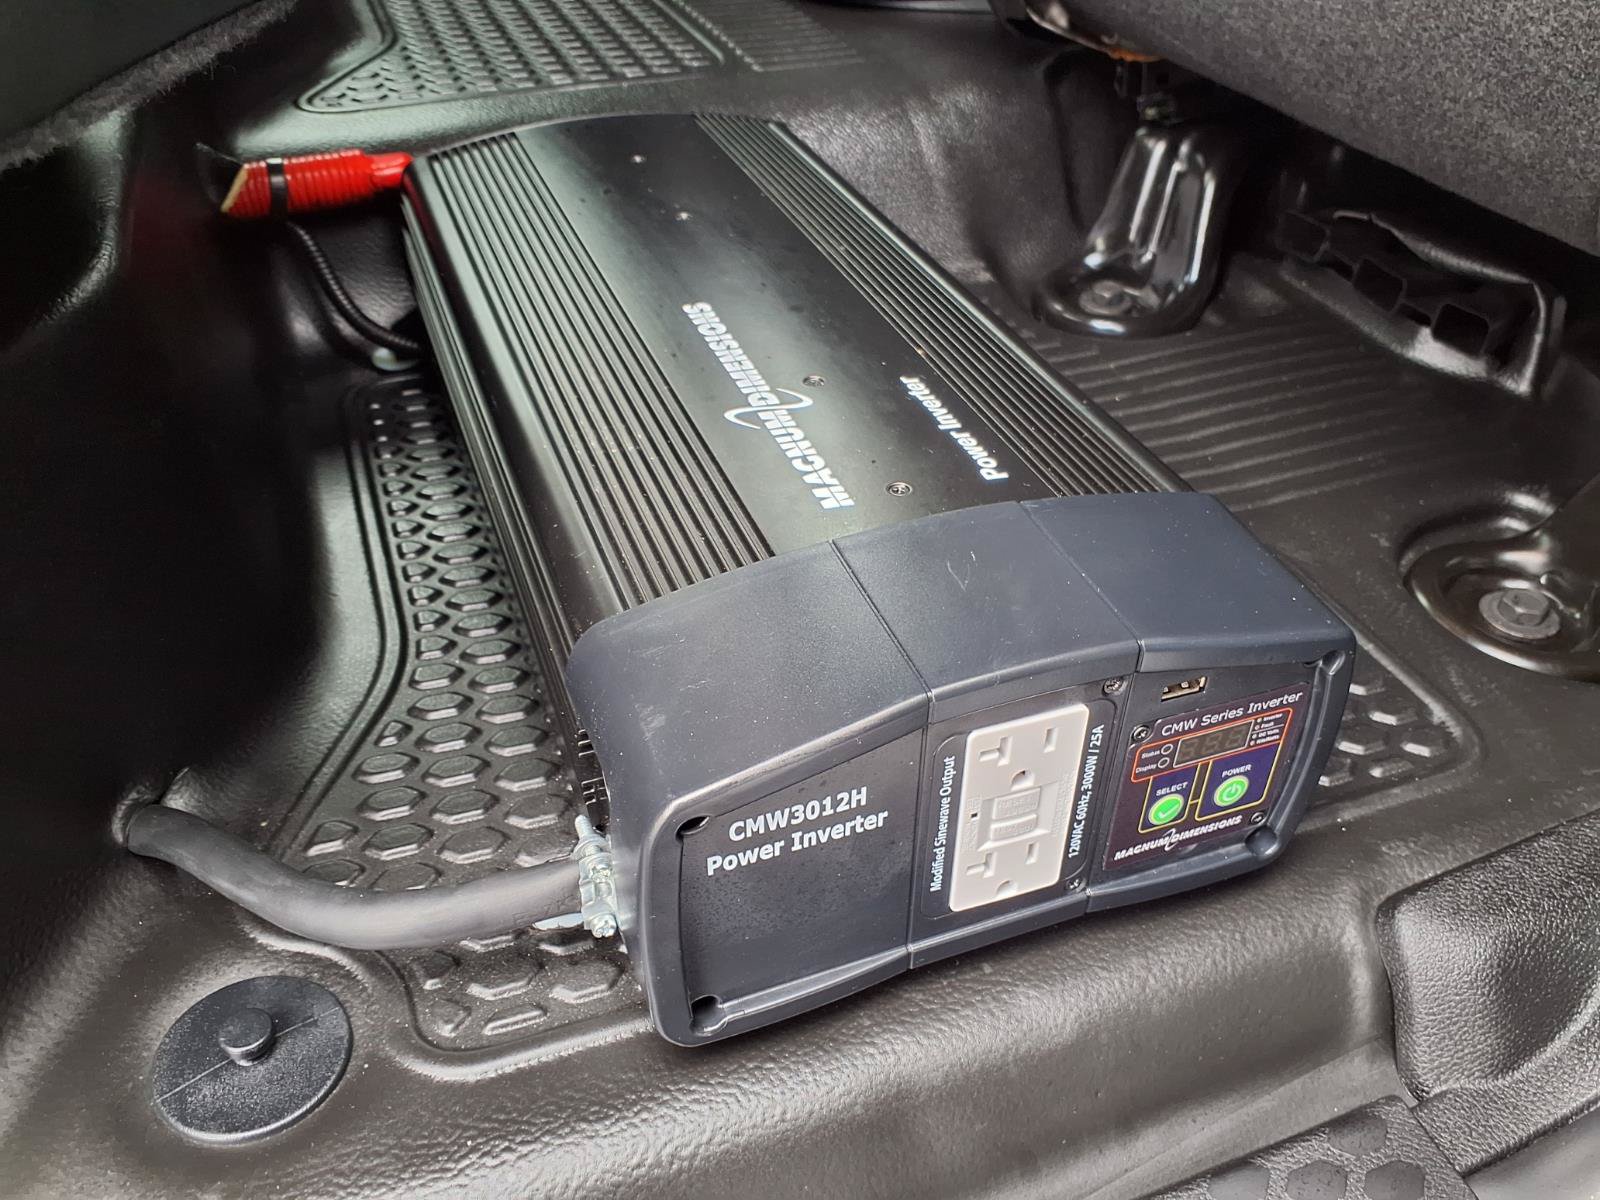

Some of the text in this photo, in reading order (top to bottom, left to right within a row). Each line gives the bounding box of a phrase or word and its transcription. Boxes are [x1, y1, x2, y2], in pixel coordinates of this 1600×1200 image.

[682, 301, 855, 510] MAGNUM DIMENSIONS
[899, 375, 1009, 480] Power Inverter
[1162, 691, 1303, 736] CMW Series Inverter
[1068, 820, 1085, 858] 120VAC
[1090, 724, 1105, 748] 25A
[1135, 763, 1157, 774] Display
[1156, 781, 1189, 797] SELECT
[1221, 764, 1252, 778] POWER
[729, 786, 867, 841] CMW3012H
[930, 755, 957, 892] Modified Sinewave Output
[1114, 815, 1243, 861] MAGNUM DIMENSIONS
[706, 810, 889, 876] Power Inverter
